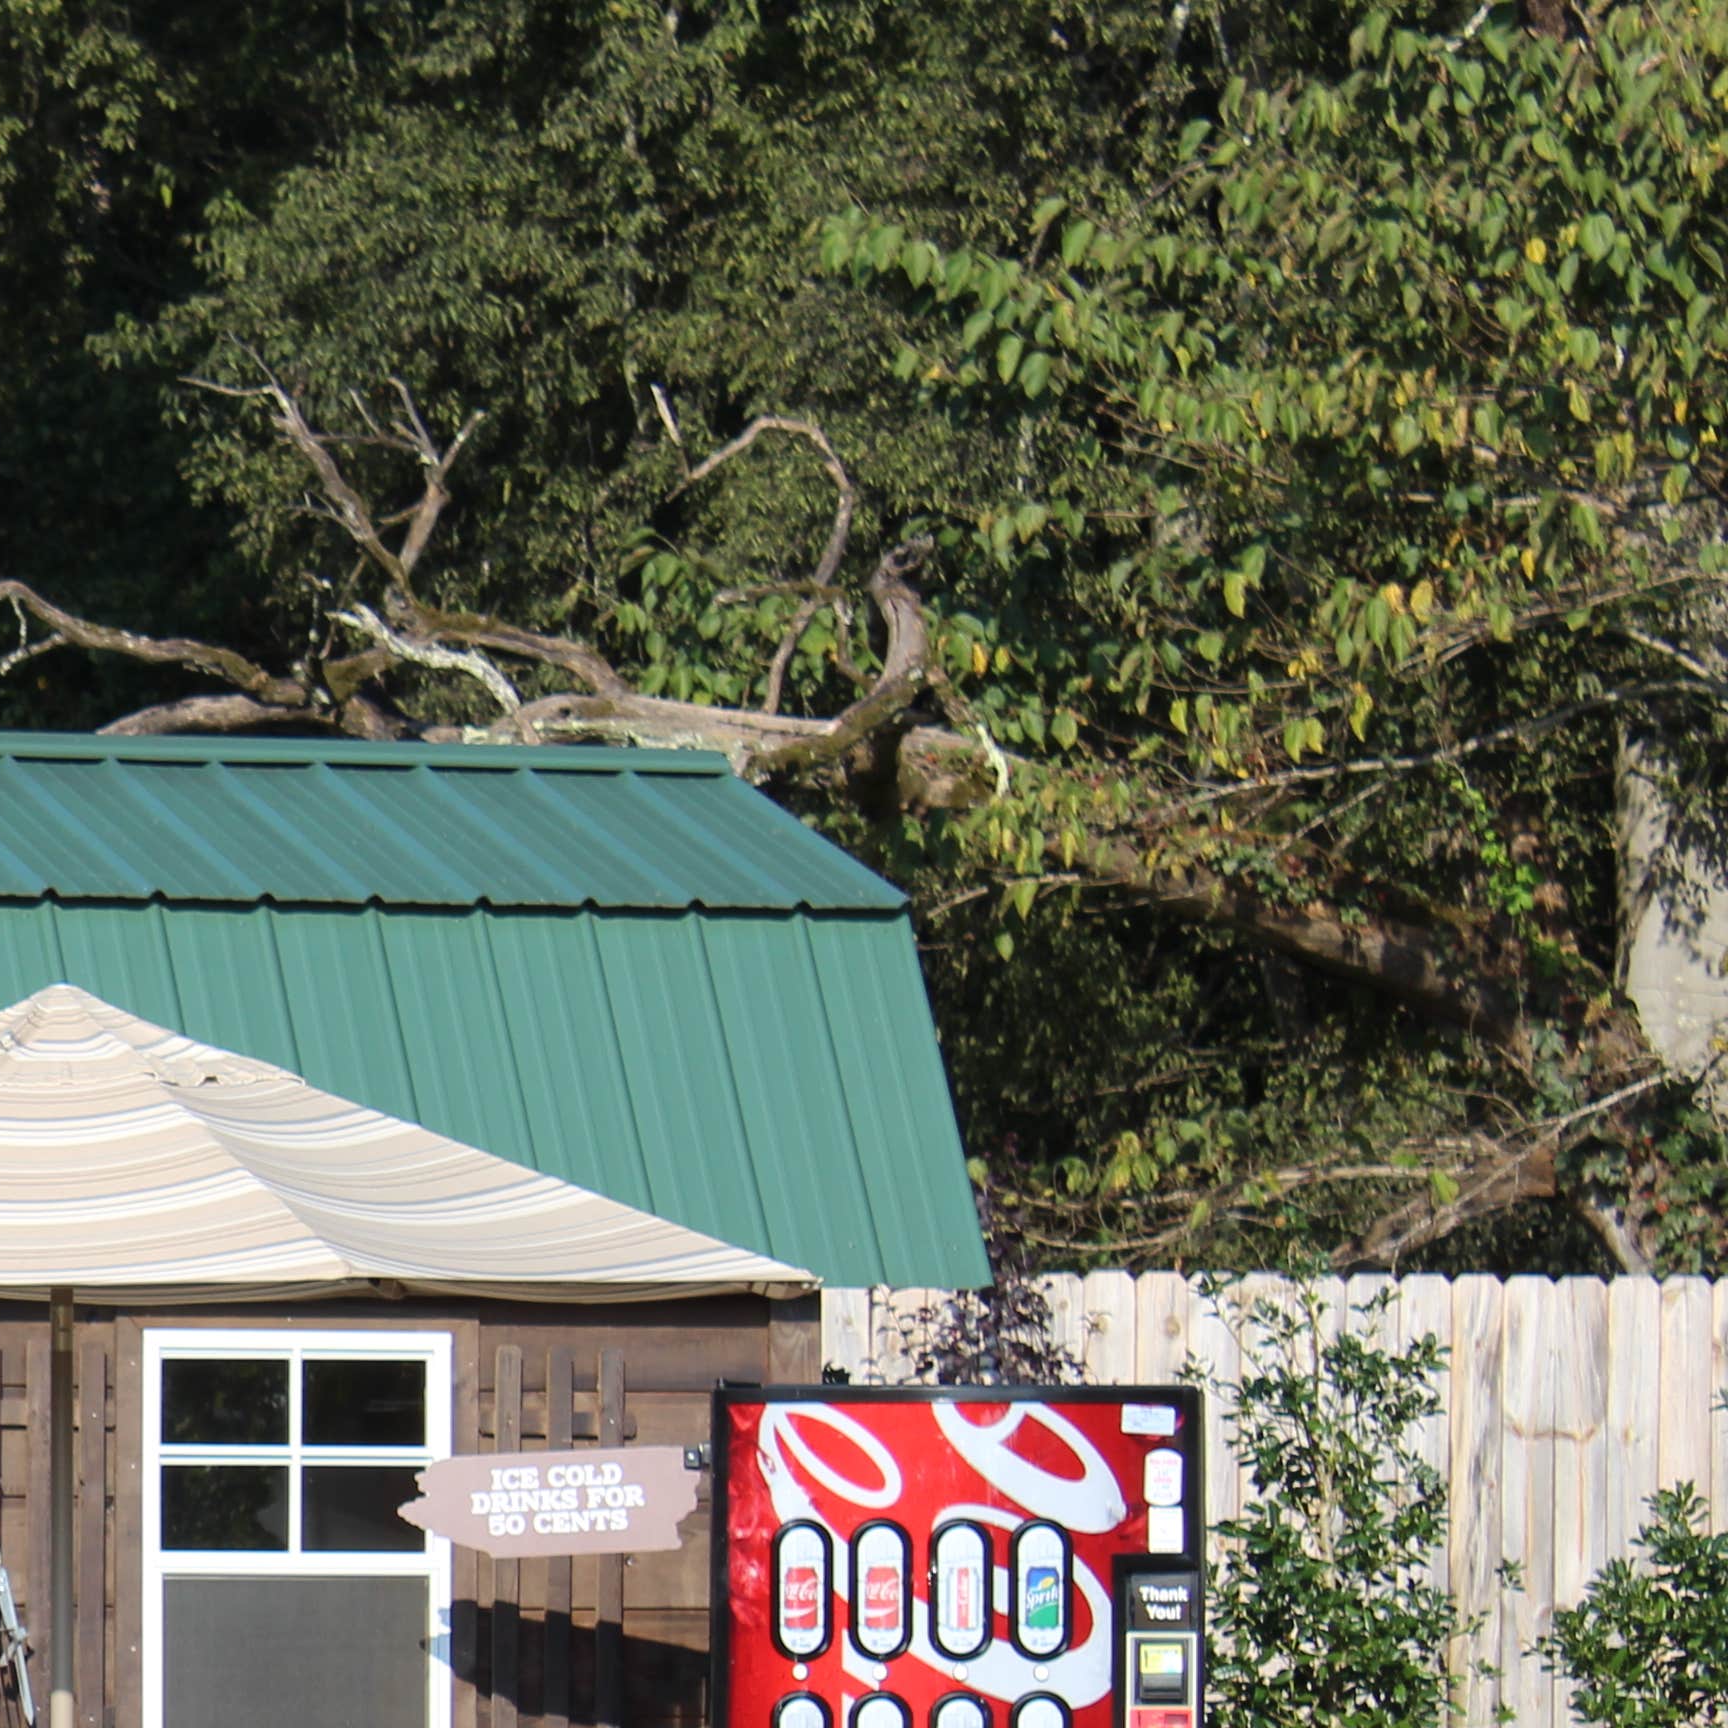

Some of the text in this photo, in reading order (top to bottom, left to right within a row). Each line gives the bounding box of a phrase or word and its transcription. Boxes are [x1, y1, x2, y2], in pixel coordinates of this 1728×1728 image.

[490, 1463, 622, 1490] ICE COLD
[470, 1485, 645, 1515] DRINKS FOR
[488, 1509, 629, 1536] 50 CENTS
[1139, 1586, 1189, 1602] Thank
[1146, 1604, 1182, 1621] You!
